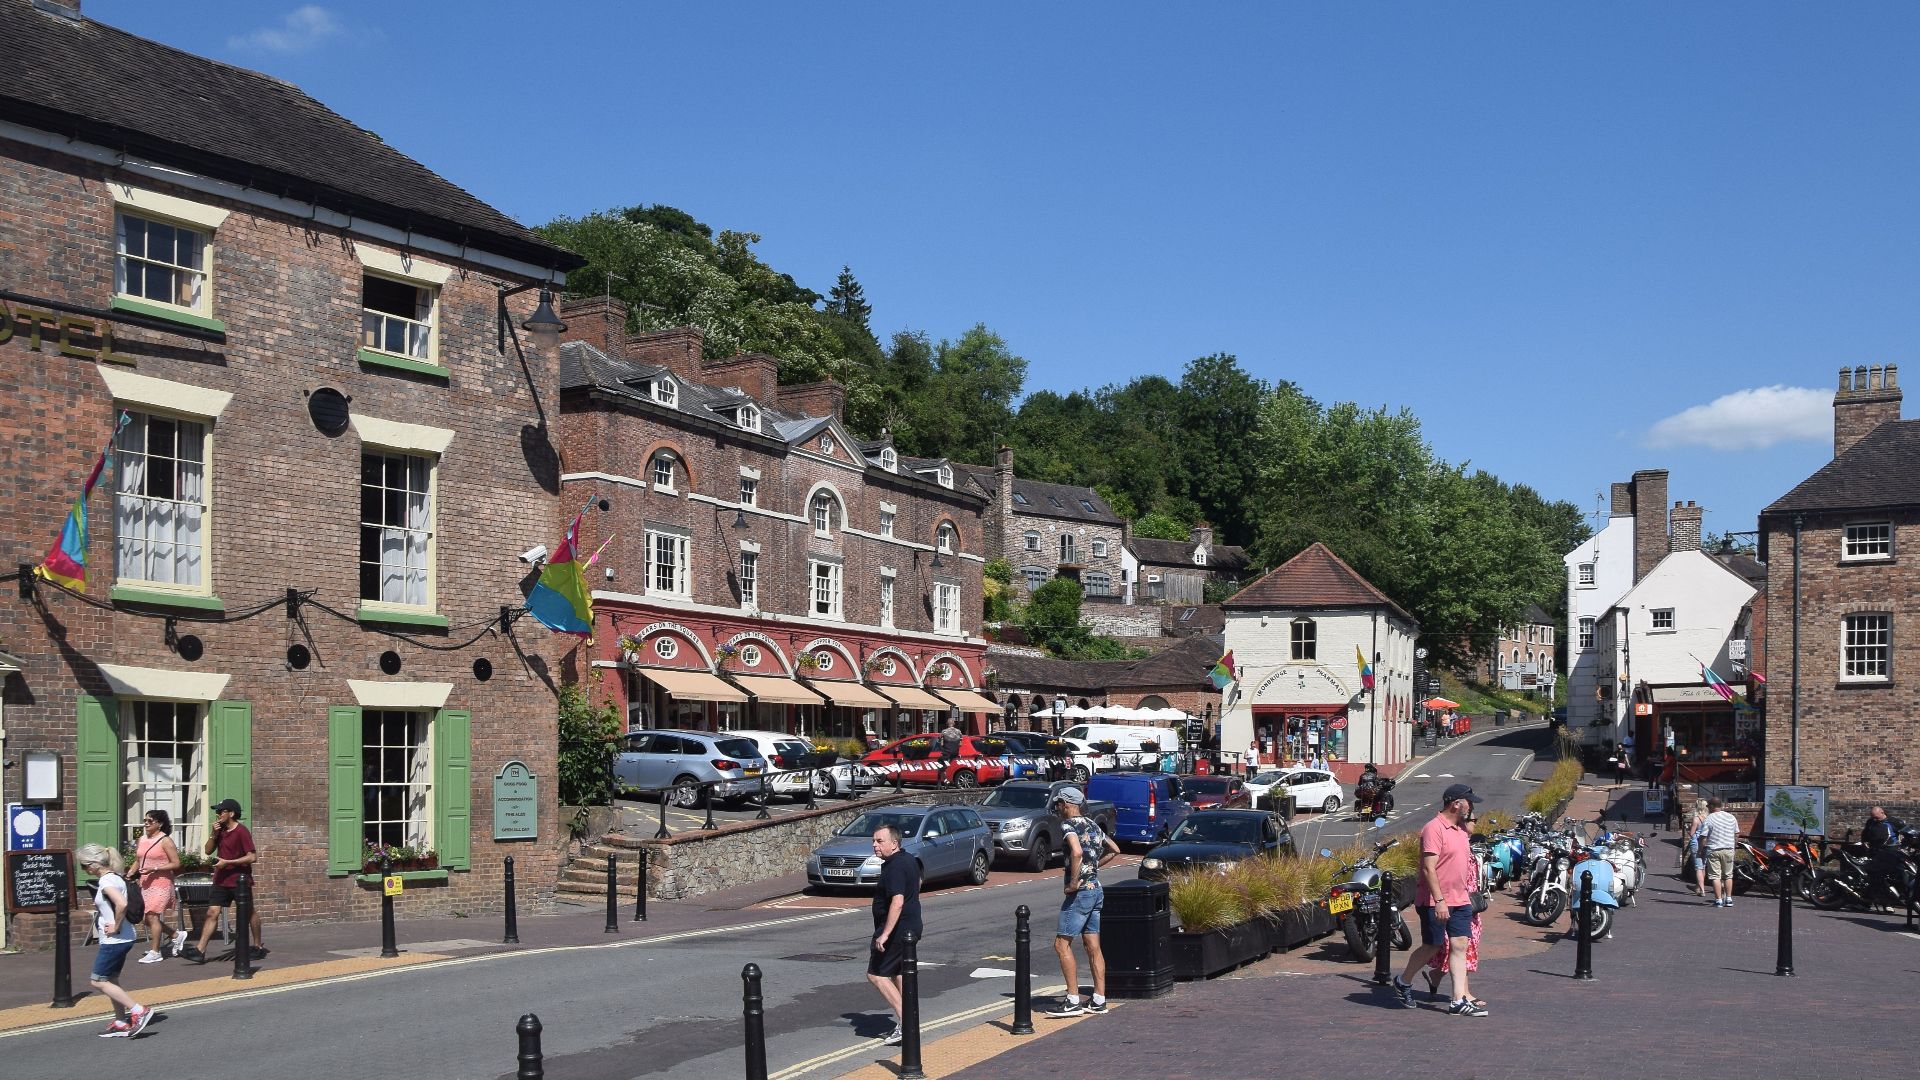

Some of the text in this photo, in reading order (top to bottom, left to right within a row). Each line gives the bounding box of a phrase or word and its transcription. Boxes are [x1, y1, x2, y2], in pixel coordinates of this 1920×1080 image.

[638, 623, 657, 637] EARS
[680, 626, 699, 645] SQUARE
[1257, 669, 1287, 697] IRONBRIDGE
[1316, 668, 1345, 696] PHARMACY
